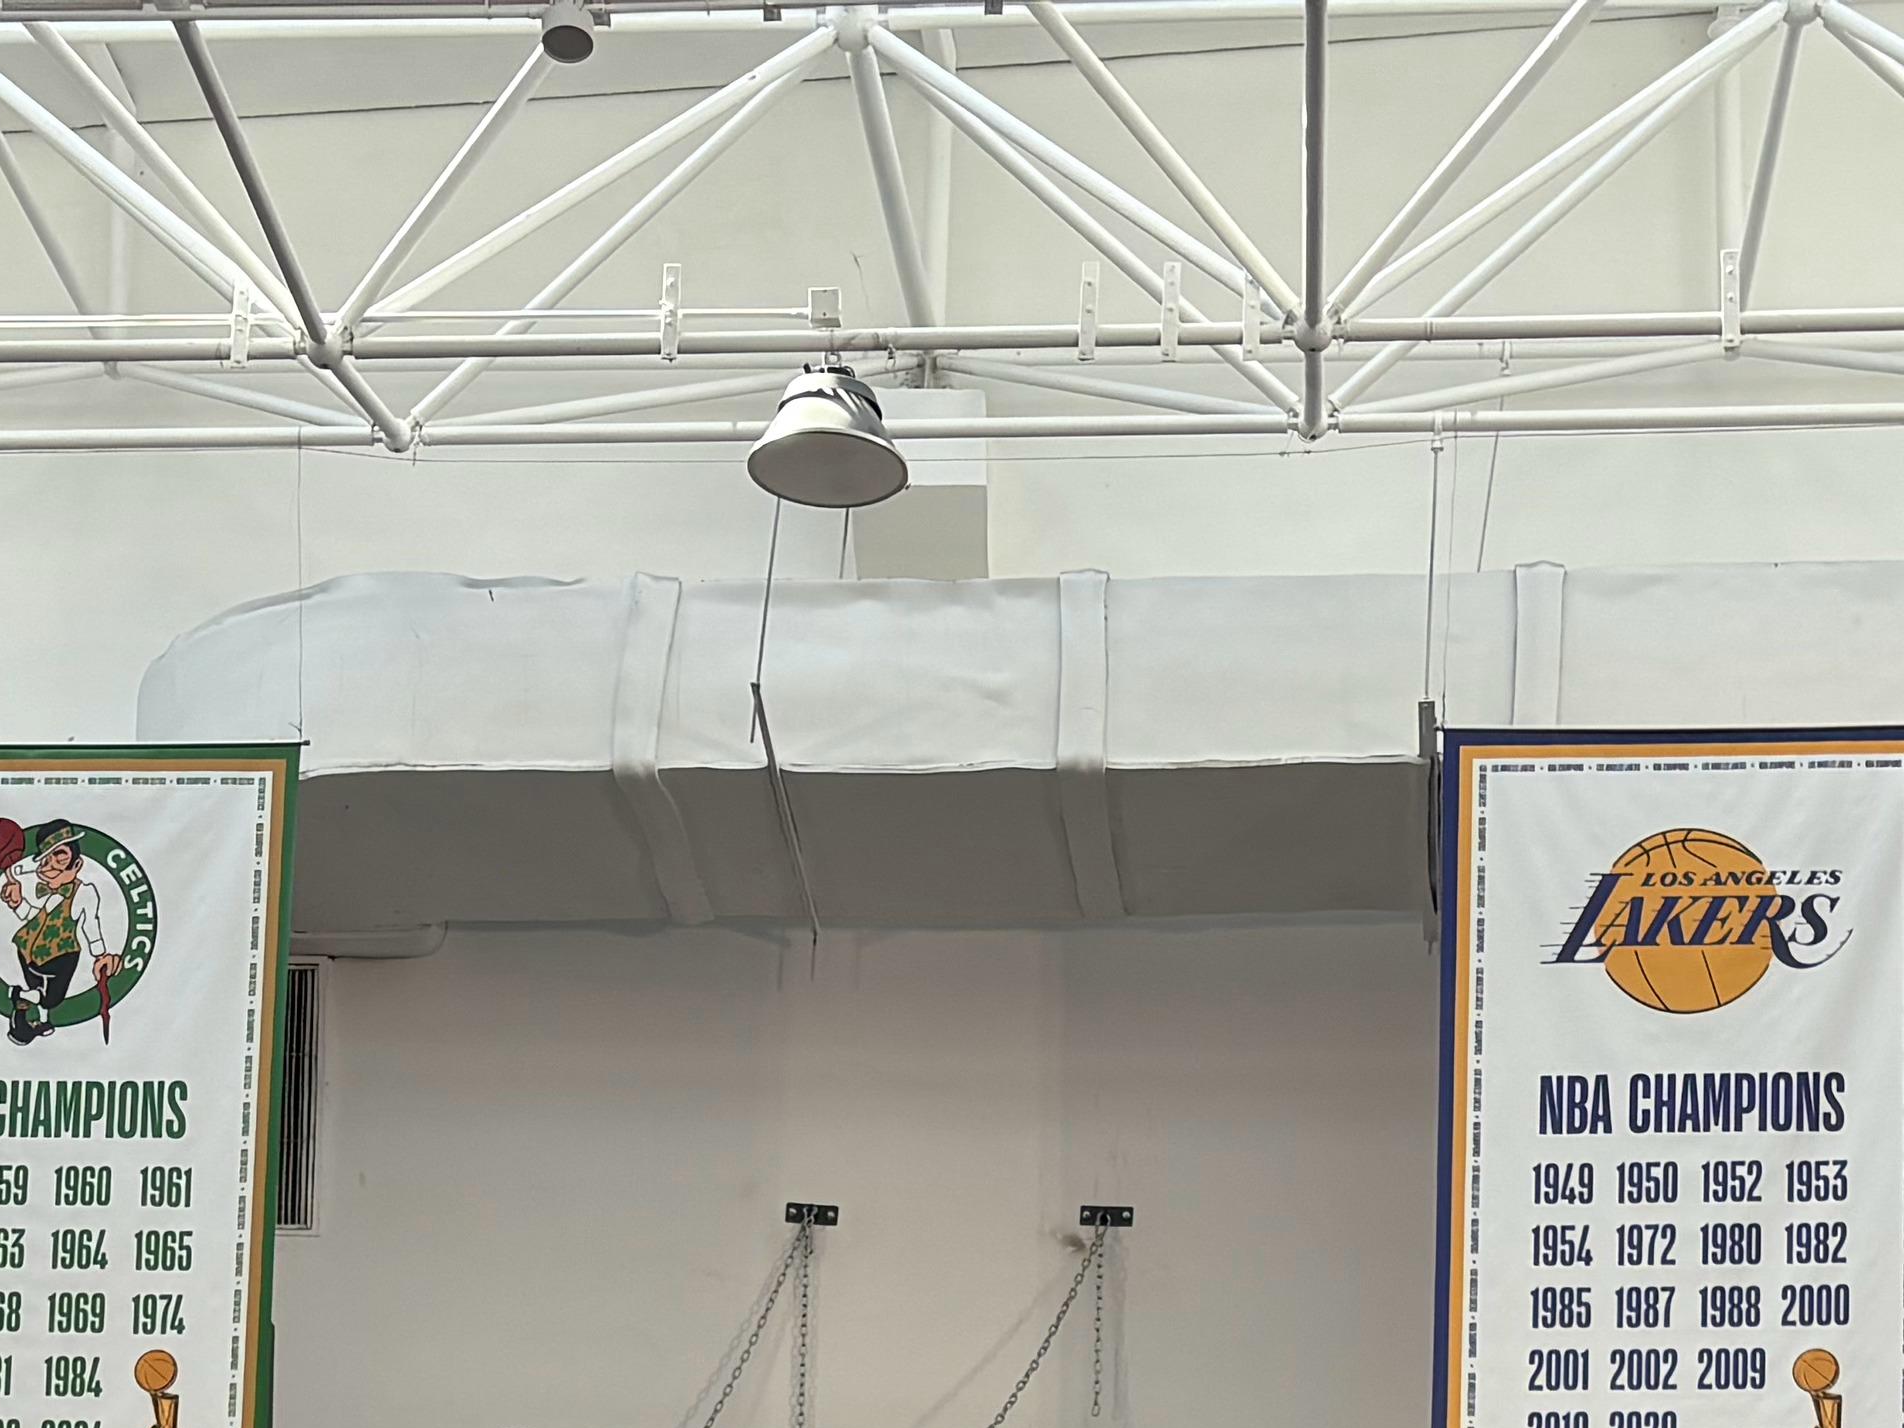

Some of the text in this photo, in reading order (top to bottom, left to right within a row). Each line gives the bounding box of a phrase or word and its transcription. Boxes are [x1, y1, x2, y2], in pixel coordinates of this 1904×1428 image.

[1641, 868, 1843, 888] LOS ANGELES
[105, 846, 154, 974] CELTICS
[1541, 872, 1853, 970] LAKERS
[1538, 1071, 1845, 1135] NBA CHAMPIONS
[54, 1165, 112, 1207] 1960
[140, 1165, 193, 1208] 1961
[1532, 1159, 1848, 1205] 1949 1950 1952 1953
[51, 1228, 109, 1270] 1964
[134, 1229, 194, 1272] 1965
[1531, 1221, 1848, 1267] 1954 1972 1980 1982
[47, 1292, 106, 1334] 1969
[131, 1293, 186, 1335] 1974
[1530, 1283, 1850, 1329] 1985 1987 1988 2000
[44, 1355, 103, 1398] 1984
[1528, 1347, 1766, 1392] 2001 2002 2009
